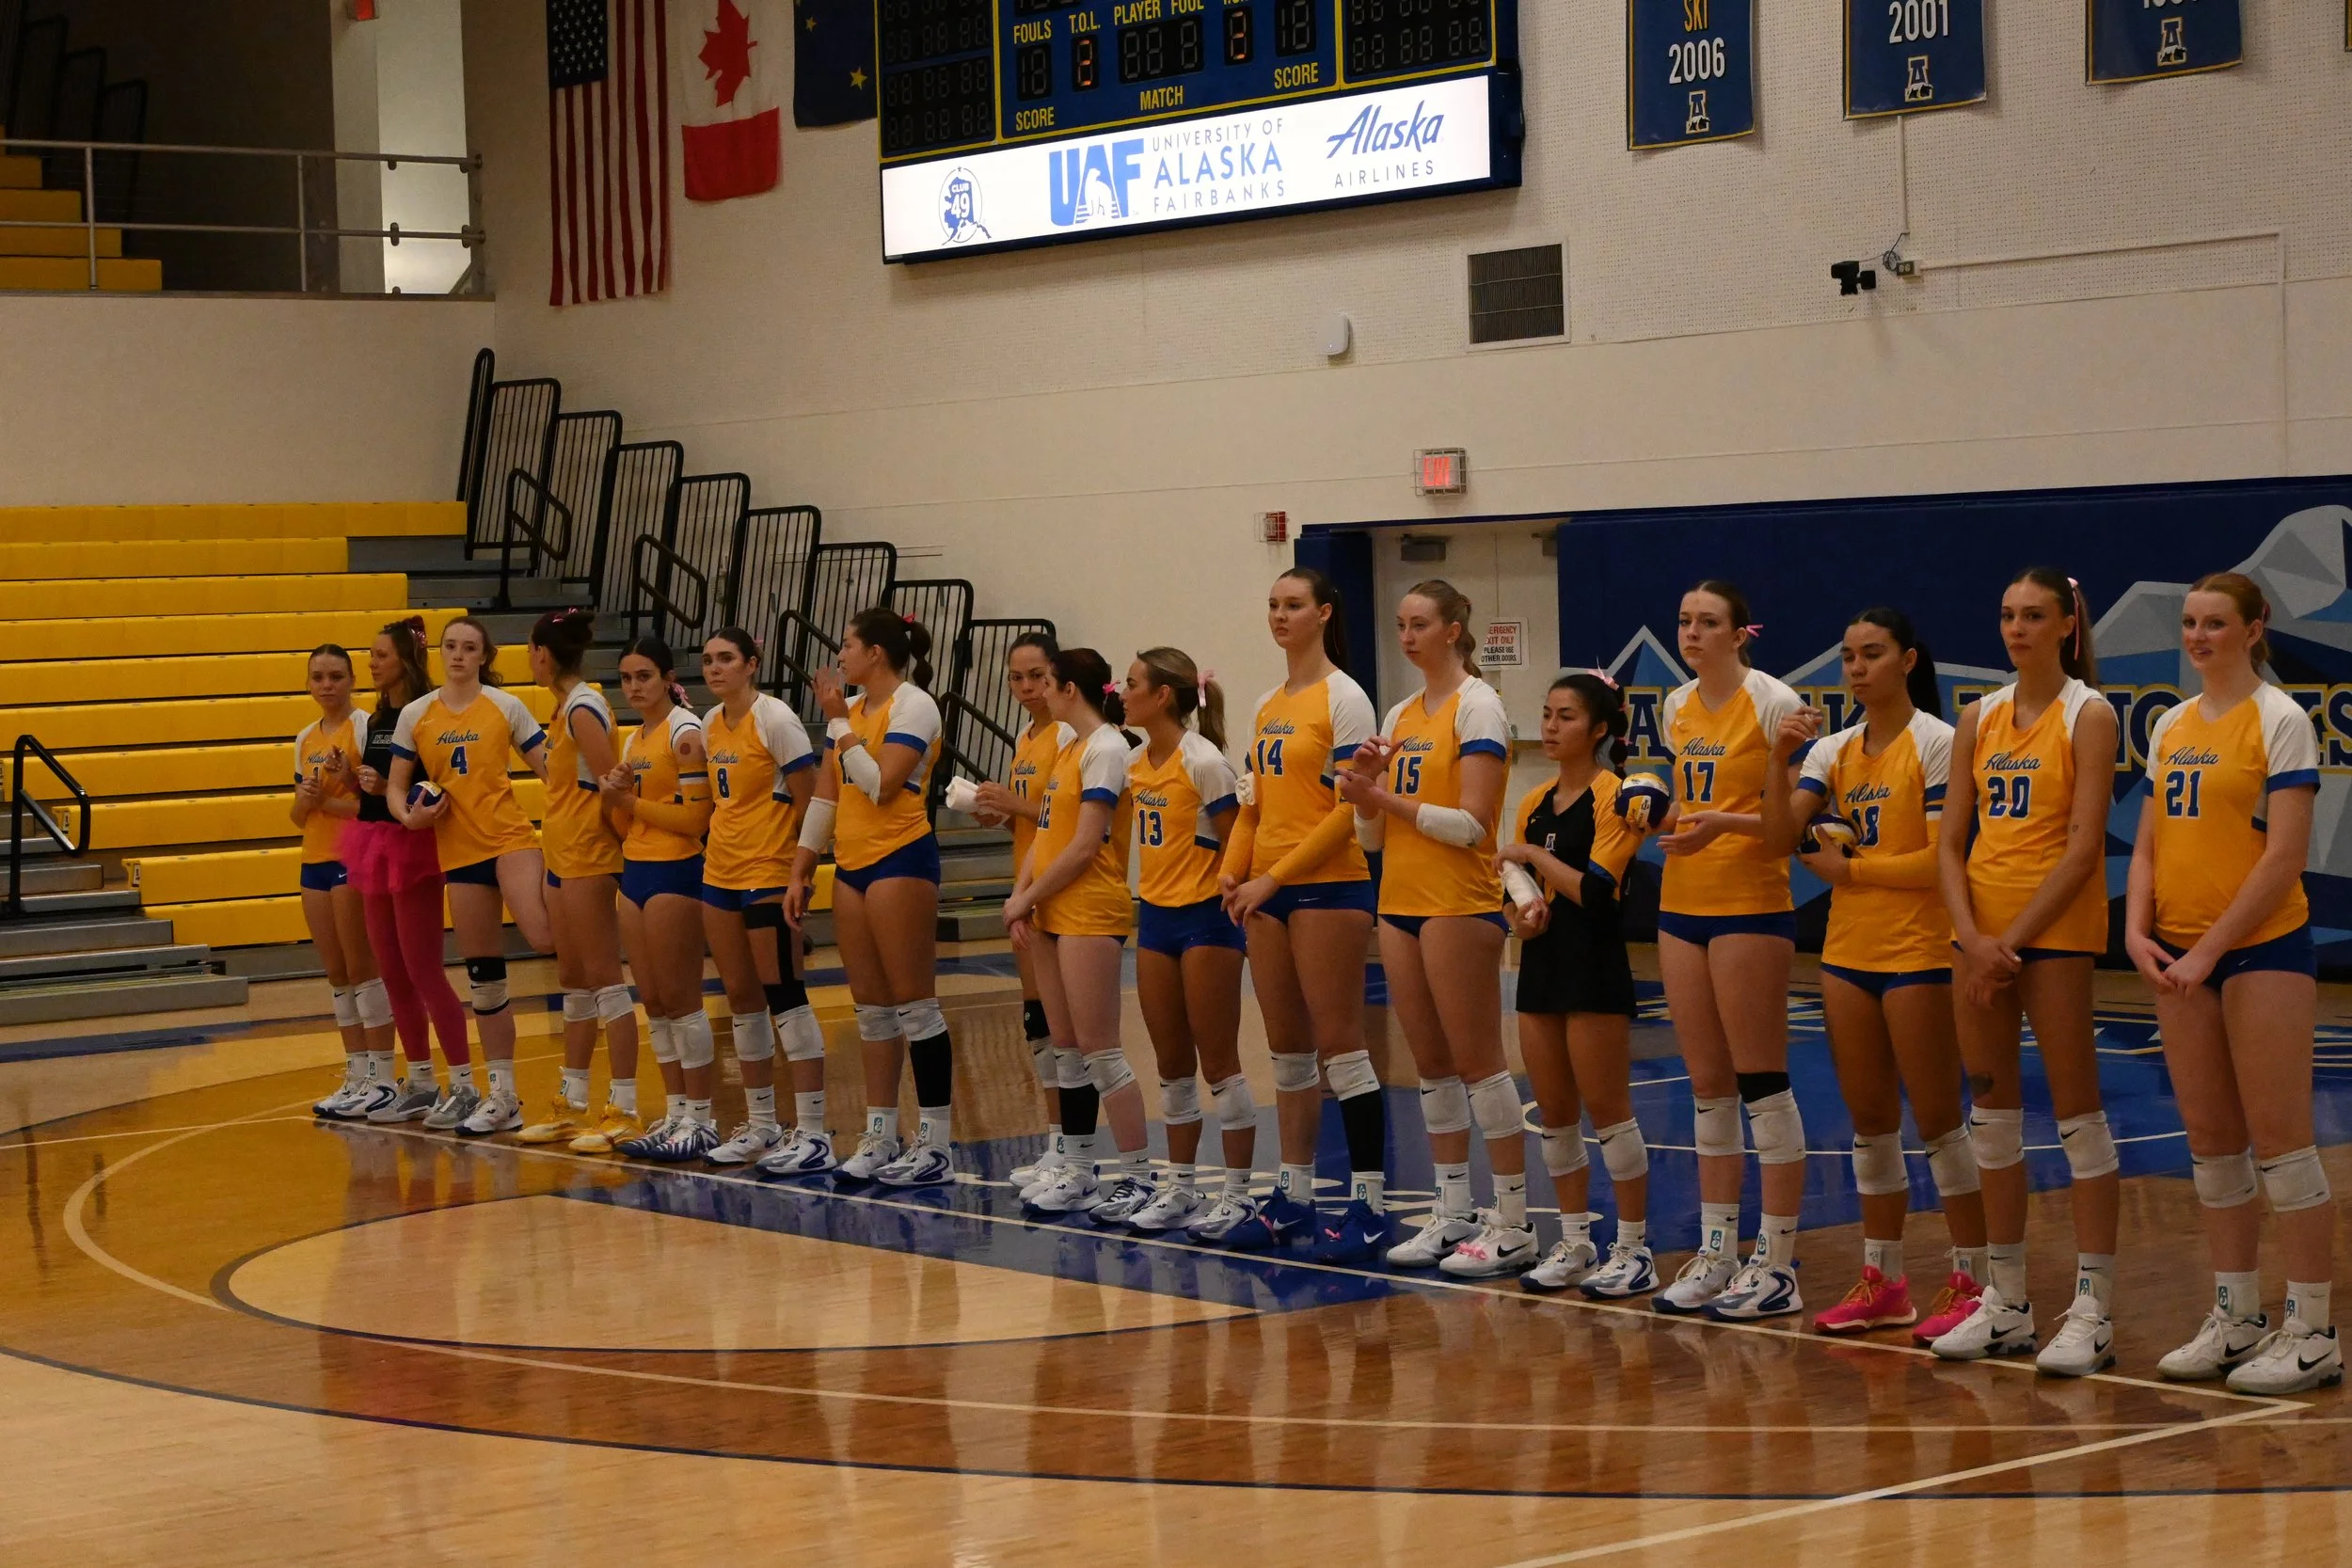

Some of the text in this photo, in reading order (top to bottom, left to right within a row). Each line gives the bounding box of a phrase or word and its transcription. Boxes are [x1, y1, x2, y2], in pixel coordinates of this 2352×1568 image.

[1069, 13, 1101, 34] T.O.L.
[1114, 0, 1162, 25] PLAYER
[1683, 0, 1709, 32] SKI
[1888, 0, 1948, 44] 2001
[1013, 20, 1052, 45] FOULS
[1668, 37, 1725, 85] 2006
[1274, 62, 1319, 90] SCORE
[1139, 86, 1184, 111] MATCH
[1015, 106, 1055, 131] SCORE
[1327, 100, 1444, 158] Alaska
[1152, 118, 1283, 151] UNIVERSITY OF
[1153, 140, 1282, 189] ALASKA
[1335, 160, 1434, 188] AIRLINES
[1049, 138, 1144, 227] UAF
[951, 192, 970, 218] 49
[1153, 180, 1284, 214] FAIRBANKS
[1489, 626, 1518, 635] ERGENCY
[1480, 655, 1501, 663] OTHER
[436, 729, 480, 746] Alaska
[1257, 718, 1295, 736] Alaska
[709, 749, 739, 765] Alaska
[1256, 737, 1284, 777] 14
[1401, 736, 1434, 752] Alaska
[1680, 736, 1726, 756] Alaska
[2164, 747, 2220, 766] Alaska
[450, 744, 469, 776] 4
[1982, 752, 2041, 770] Alaska
[717, 767, 731, 799] 8
[1394, 754, 1422, 796] 15
[1682, 760, 1716, 803] 17
[1135, 788, 1168, 808] Alaska
[1986, 774, 2031, 819] 20
[2164, 768, 2202, 820] 21
[1138, 808, 1164, 848] 13
[1851, 804, 1882, 847] 18
